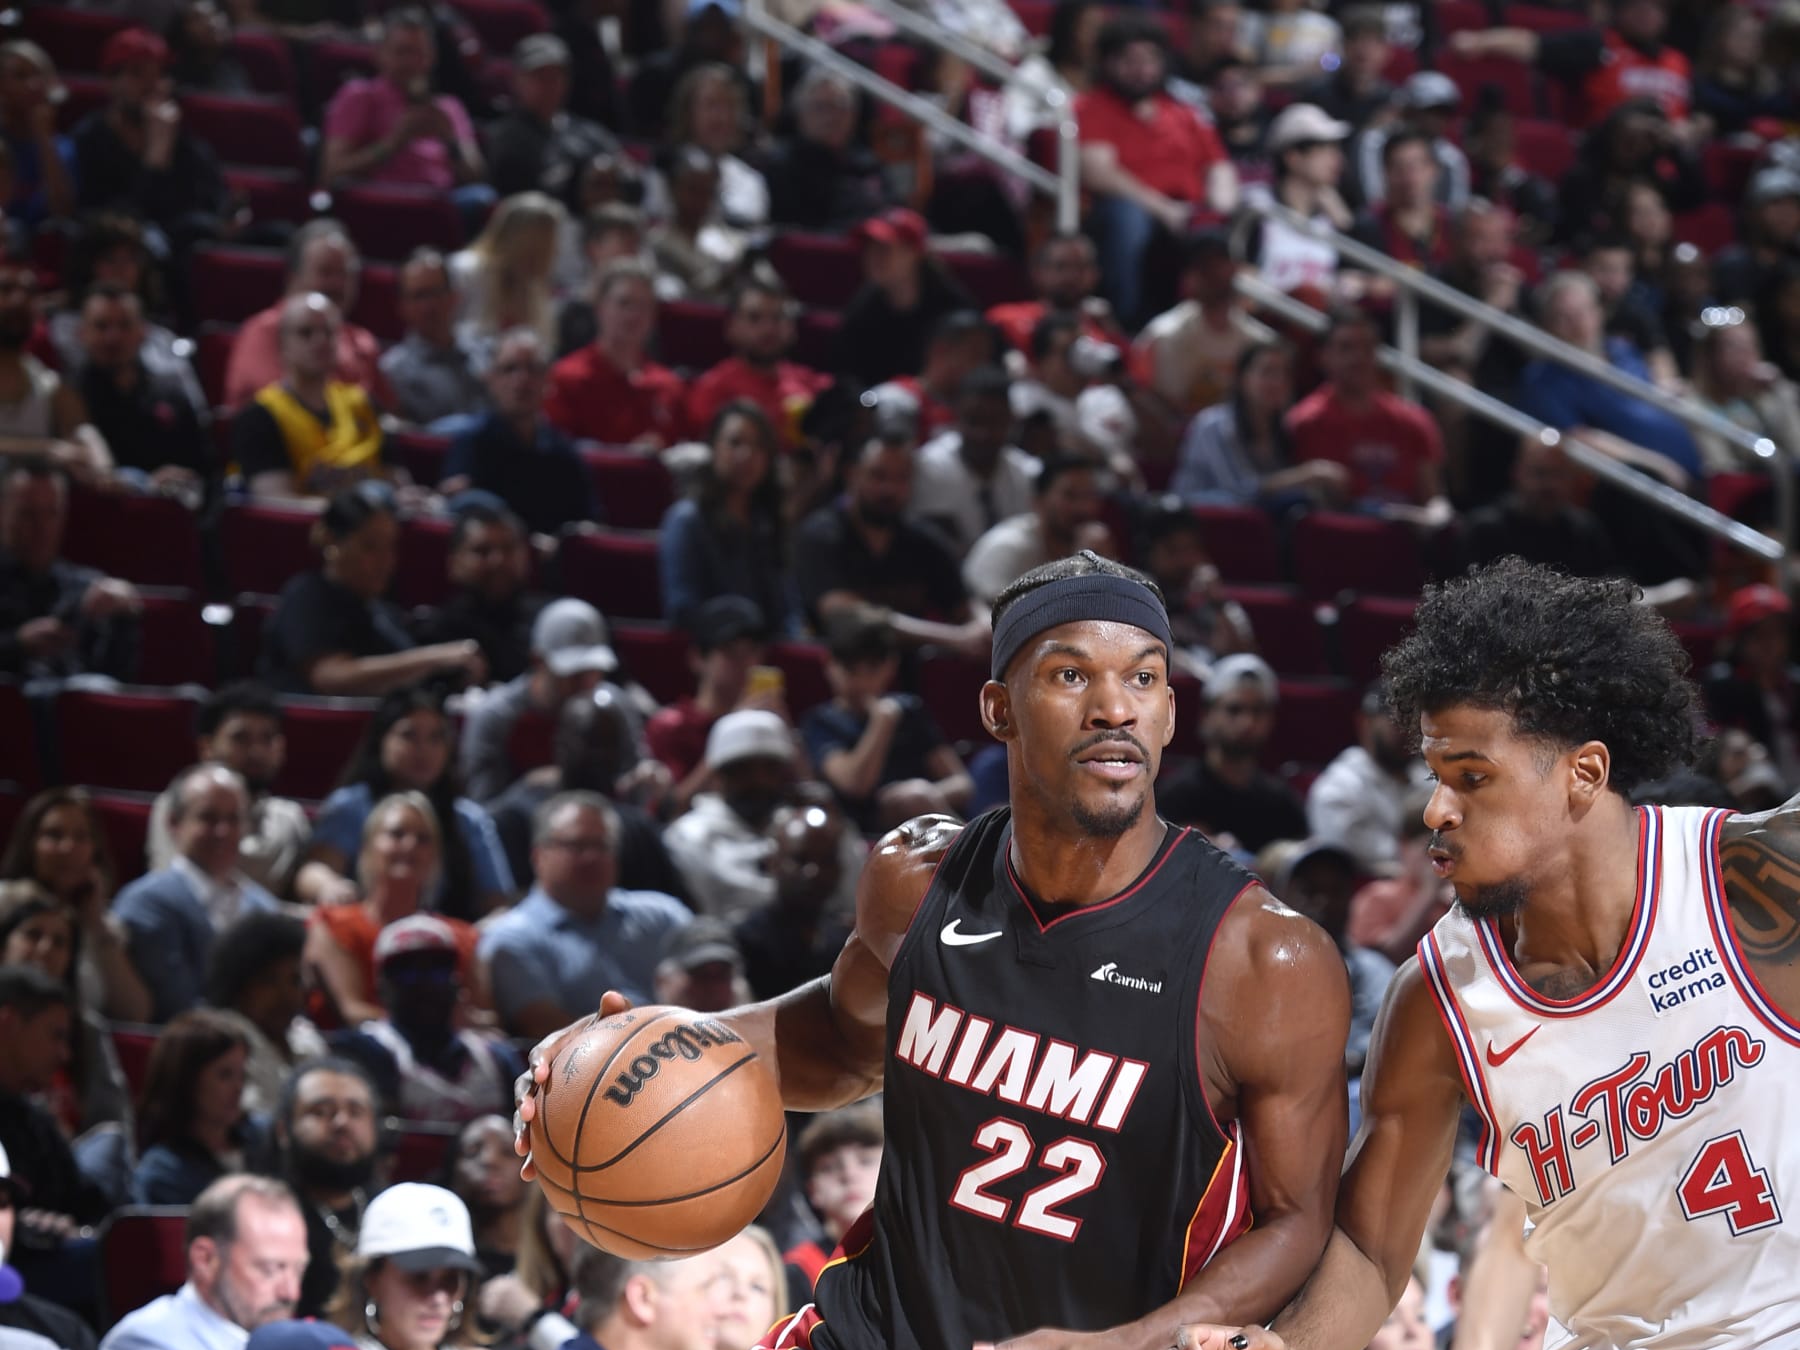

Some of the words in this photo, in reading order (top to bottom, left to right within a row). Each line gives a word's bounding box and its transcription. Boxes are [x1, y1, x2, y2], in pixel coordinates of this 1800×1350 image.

[1107, 971, 1162, 994] Carnival
[1648, 948, 1717, 990] credit
[1650, 970, 1726, 1013] karma
[895, 990, 1150, 1133] MIAMI
[1511, 1025, 1765, 1208] H-Town
[949, 1116, 1107, 1242] 22
[1676, 1130, 1783, 1236] 4
